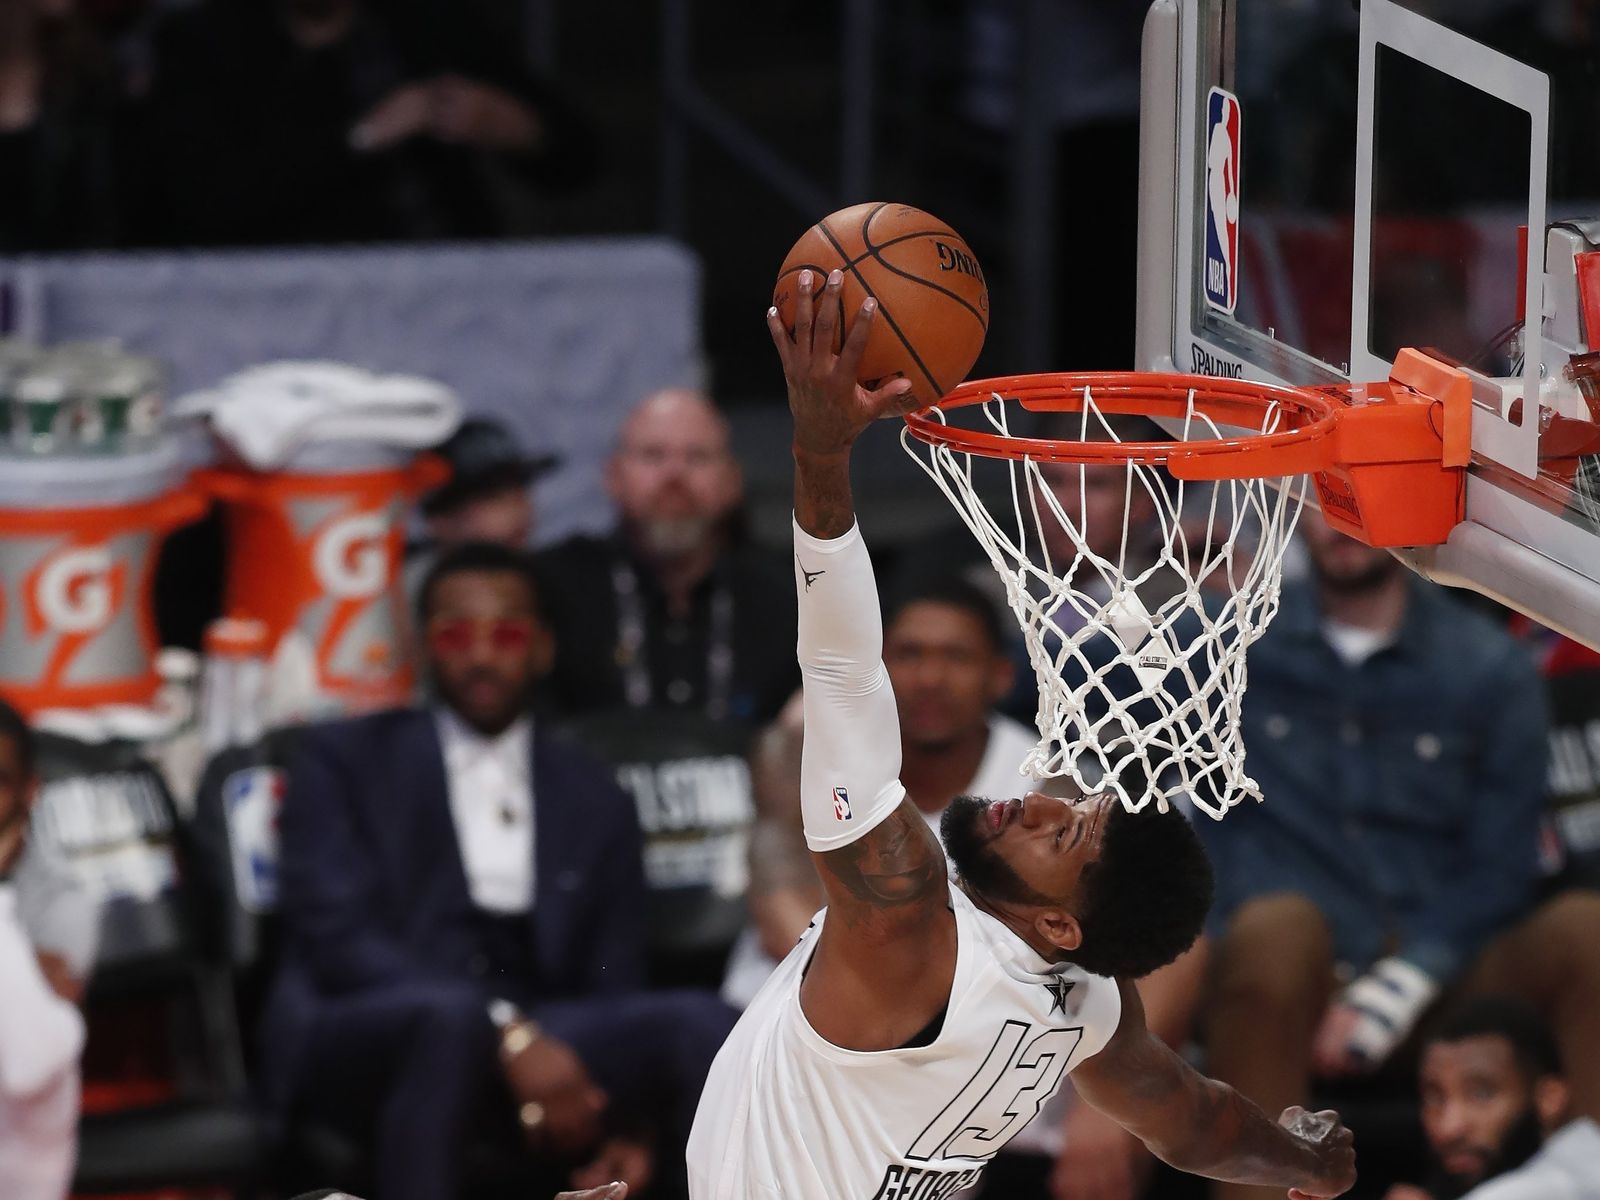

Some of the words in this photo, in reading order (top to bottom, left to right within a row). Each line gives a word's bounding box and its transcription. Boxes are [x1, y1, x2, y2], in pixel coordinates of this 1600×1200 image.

[1208, 257, 1224, 296] NBA
[1191, 342, 1243, 379] SPALDING
[37, 548, 112, 634] G
[314, 515, 390, 598] G
[904, 1019, 1084, 1161] 13
